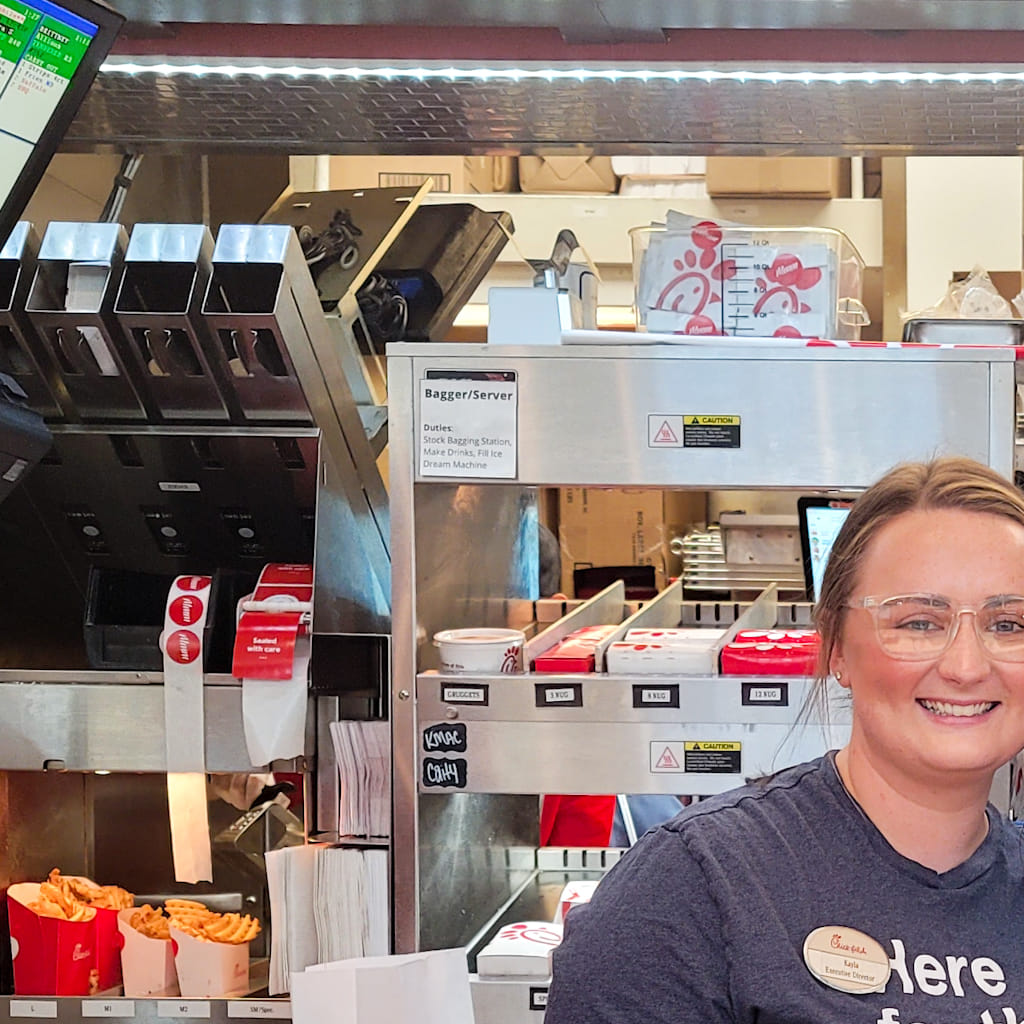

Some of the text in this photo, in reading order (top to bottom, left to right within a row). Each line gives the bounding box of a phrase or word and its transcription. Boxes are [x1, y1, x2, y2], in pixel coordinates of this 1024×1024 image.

[425, 388, 513, 402] Bagger/Server
[423, 436, 446, 445] Stock
[447, 437, 480, 447] Bagging
[423, 448, 446, 457] Make
[423, 460, 488, 469] Dream Machine
